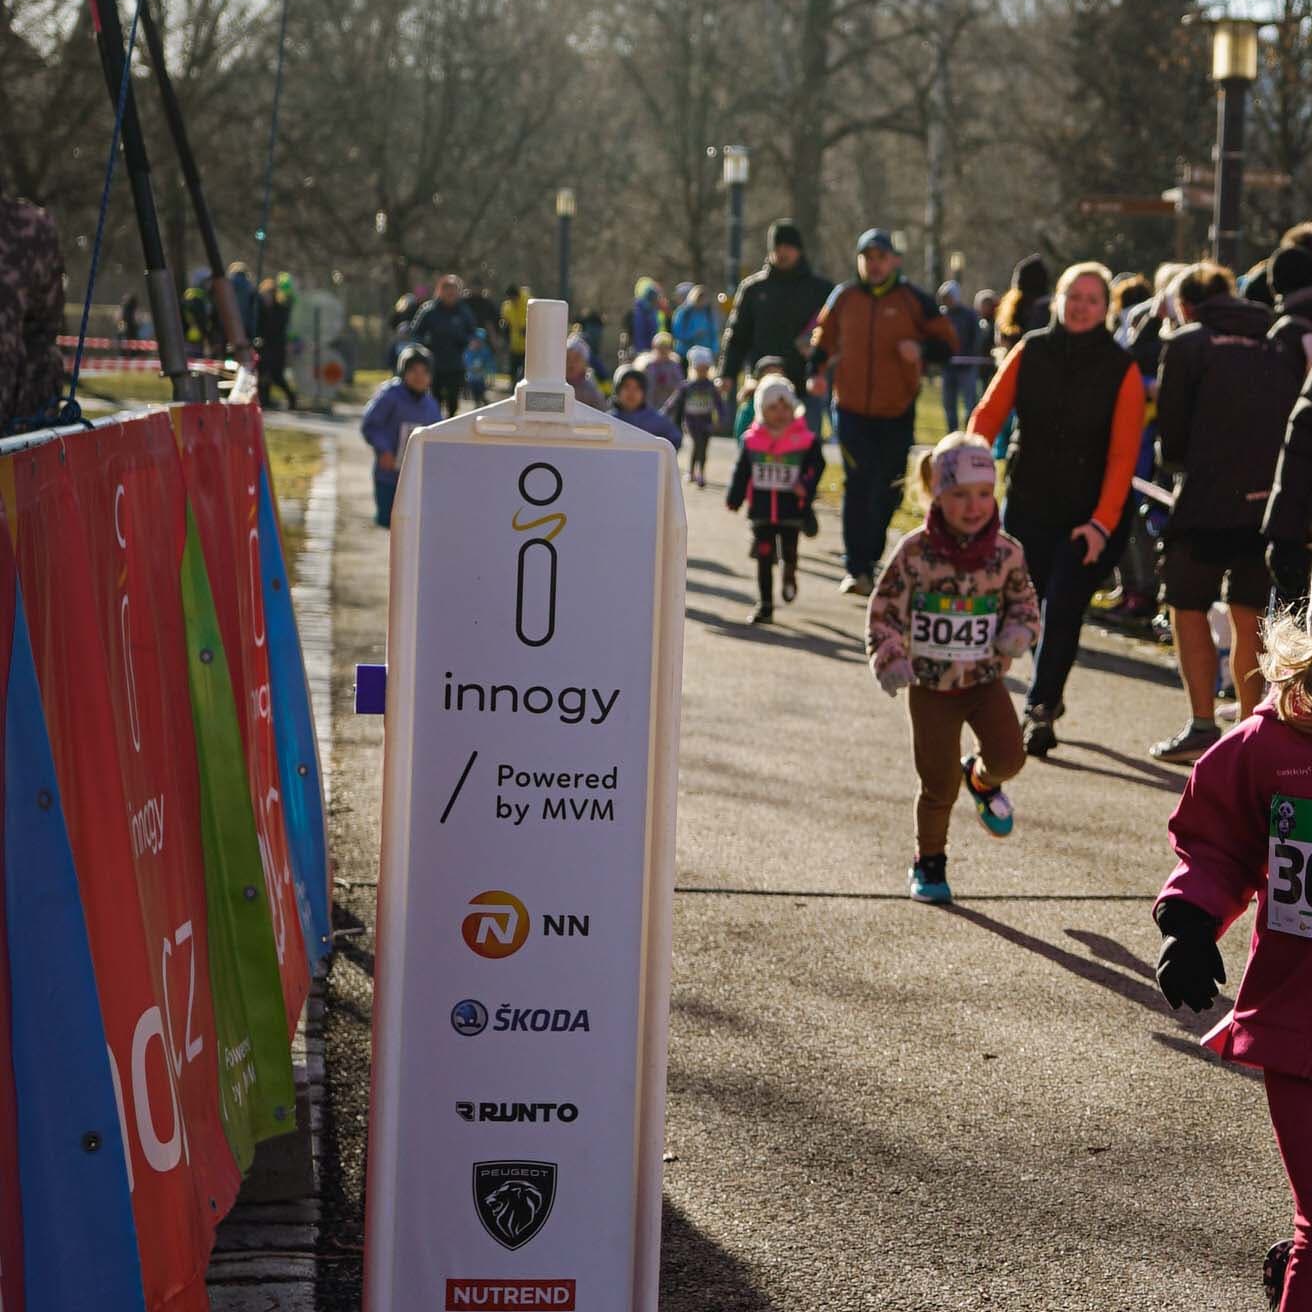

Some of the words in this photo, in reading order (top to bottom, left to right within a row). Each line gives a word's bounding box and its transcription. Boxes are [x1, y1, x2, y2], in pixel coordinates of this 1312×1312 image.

[913, 614, 990, 646] 3043
[443, 671, 620, 725] innogy
[497, 764, 618, 790] Powered
[495, 795, 530, 825] by
[541, 797, 615, 821] MVM
[542, 914, 590, 937] NN
[493, 1003, 591, 1033] ŠKODA
[479, 1101, 579, 1123] RUNTO
[480, 1168, 549, 1177] PEUGEOT
[453, 1285, 571, 1306] NUTREND
